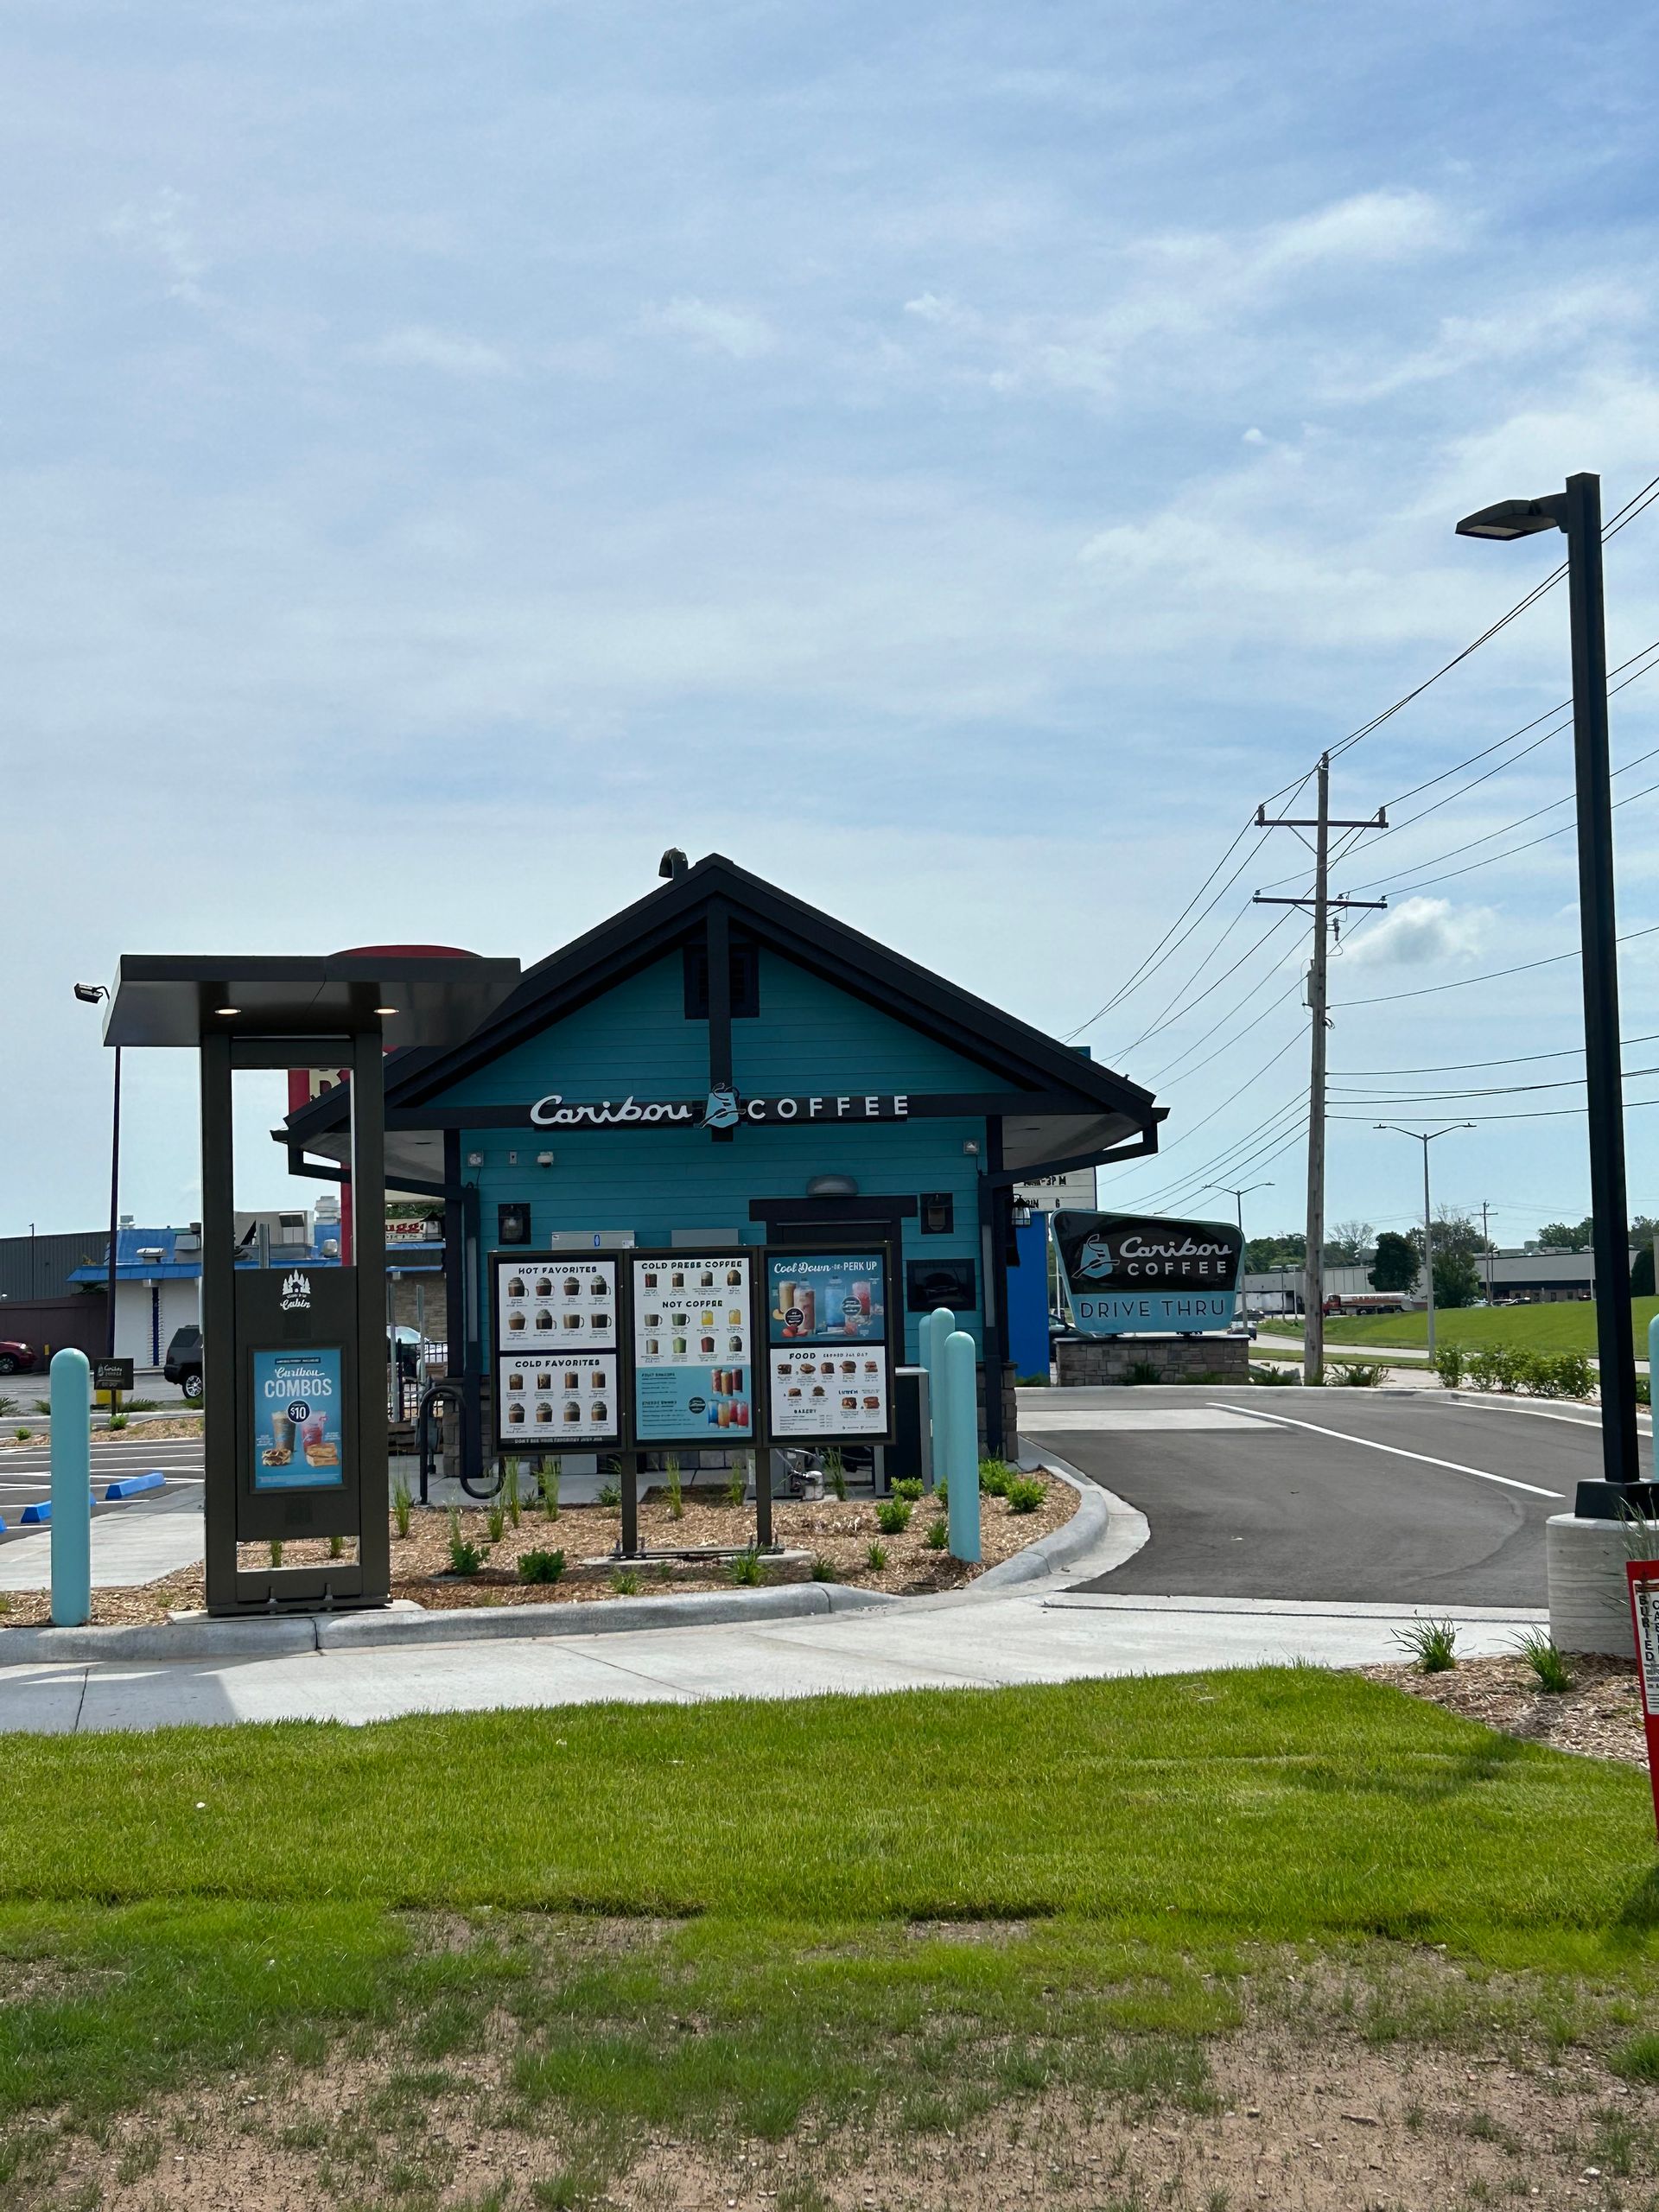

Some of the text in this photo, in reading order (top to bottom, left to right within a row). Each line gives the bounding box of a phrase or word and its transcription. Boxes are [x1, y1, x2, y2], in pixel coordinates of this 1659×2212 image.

[531, 1095, 907, 1124] Caribou COFFEE
[1119, 1236, 1232, 1258] Caribou
[542, 1266, 597, 1274] FAVORITES
[773, 1262, 798, 1274] Cool
[798, 1262, 831, 1274] Down
[843, 1262, 865, 1272] PERK
[866, 1261, 878, 1271] UP
[1127, 1261, 1227, 1276] COFFEE
[1080, 1300, 1224, 1319] DRIVE THRU
[544, 1359, 601, 1368] FAVORITES
[274, 1367, 326, 1379] Caribou
[264, 1378, 332, 1398] COMBOS
[289, 1406, 307, 1420] $10
